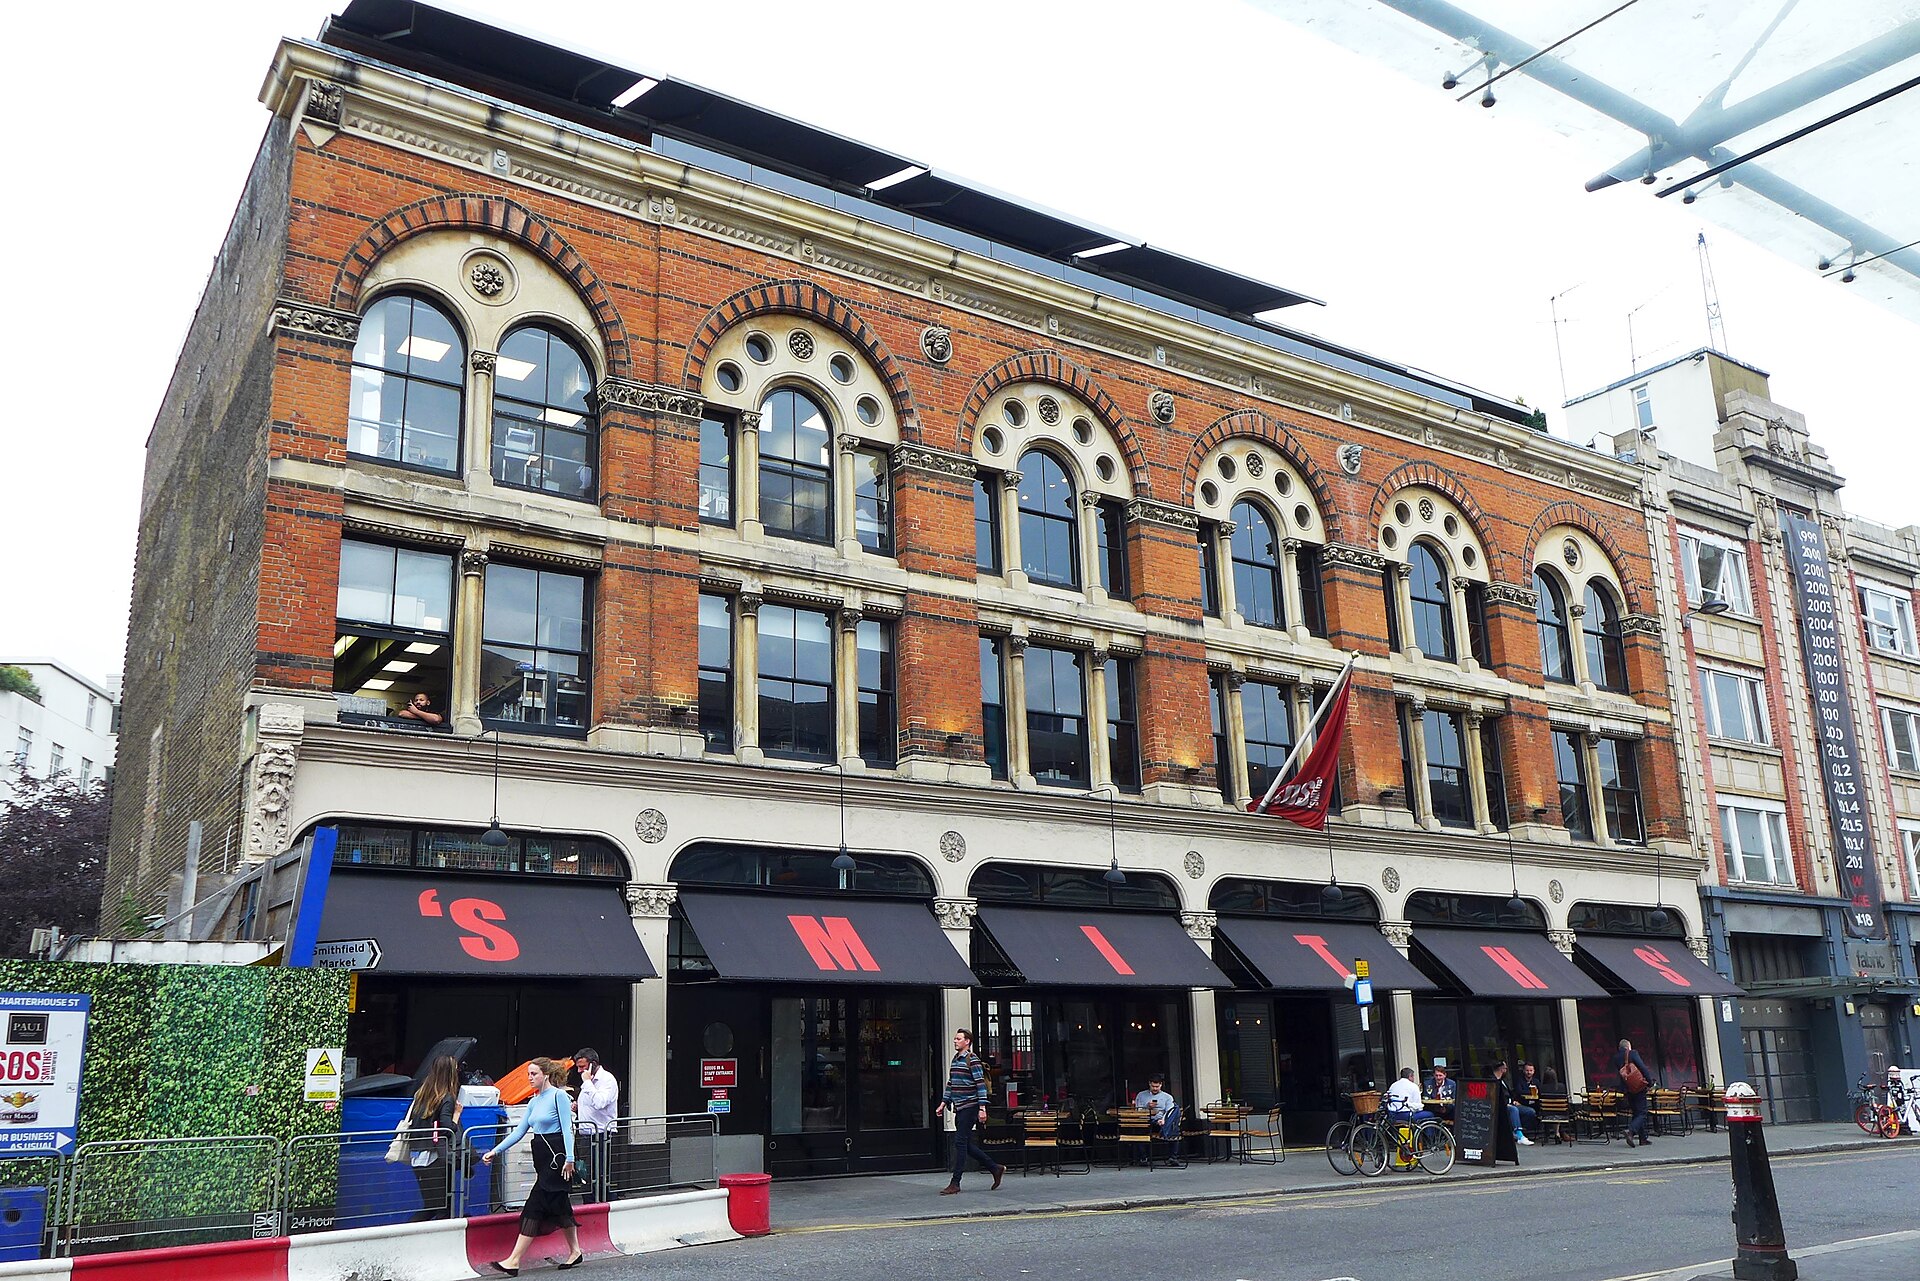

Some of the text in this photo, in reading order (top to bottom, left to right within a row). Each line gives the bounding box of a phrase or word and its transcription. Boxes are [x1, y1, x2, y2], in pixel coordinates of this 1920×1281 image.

[1803, 563, 1826, 579] 2001
[1805, 580, 1830, 596] 2002
[1807, 598, 1833, 614] 2003
[1807, 617, 1834, 631] 2004
[1812, 652, 1838, 668] 2006
[1815, 671, 1839, 686] 2007
[1819, 688, 1839, 702] 200
[1832, 762, 1853, 777] 012
[312, 943, 366, 956] Smithfield
[786, 914, 882, 972] M
[1292, 934, 1355, 981] T
[1479, 945, 1550, 990] H
[1632, 944, 1692, 988] S
[319, 957, 357, 969] Market
[68, 998, 80, 1007] ST
[13, 1022, 44, 1032] PAUL
[1467, 1082, 1487, 1099] SOS
[10, 1132, 55, 1142] BUSINESS
[24, 1141, 53, 1149] USUAL
[290, 1216, 335, 1229] 24 hour
